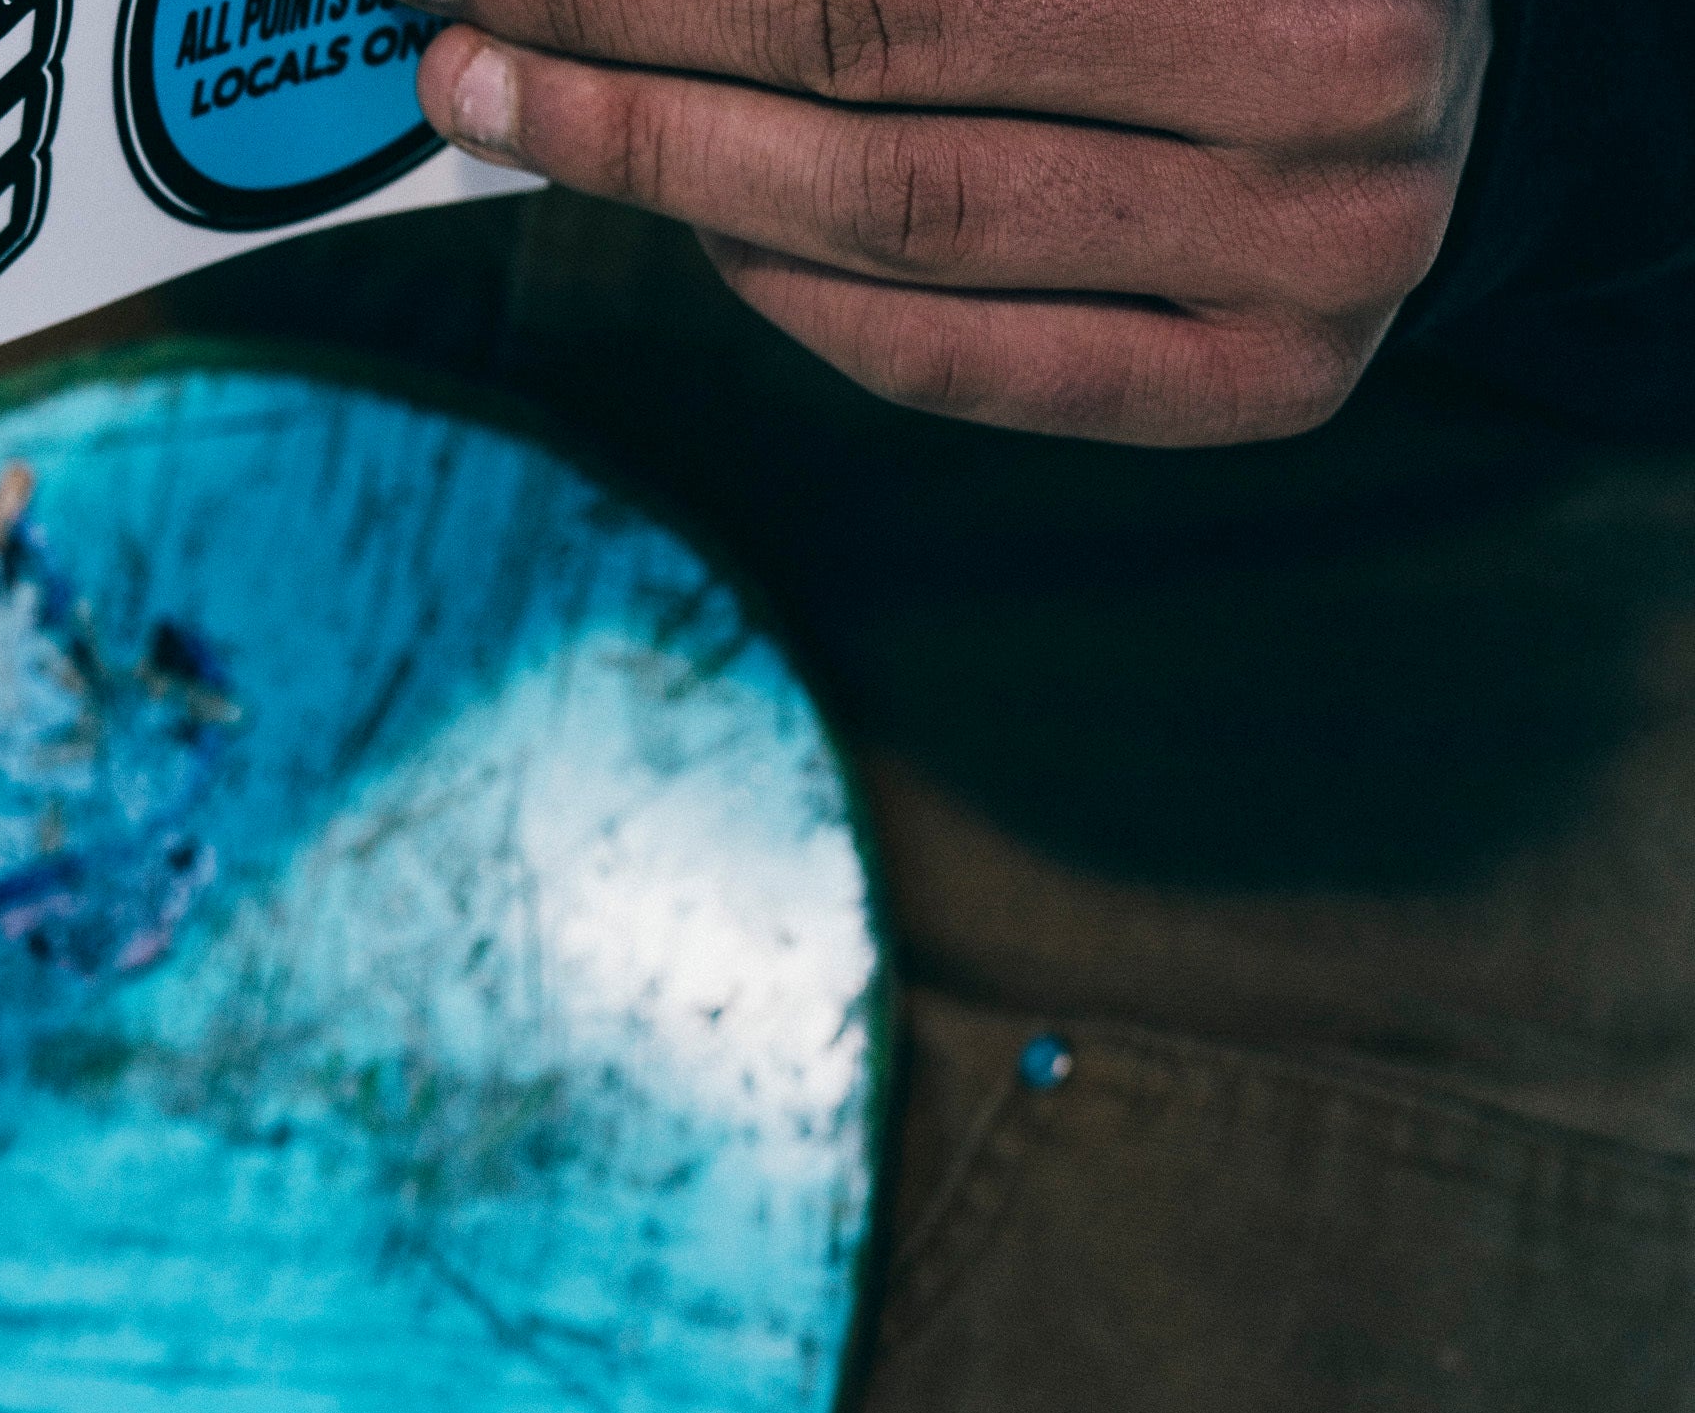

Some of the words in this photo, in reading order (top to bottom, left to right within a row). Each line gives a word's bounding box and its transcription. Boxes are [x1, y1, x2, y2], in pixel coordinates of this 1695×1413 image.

[175, 0, 232, 69] ALL
[191, 34, 352, 119] LOCALS
[362, 15, 448, 67] ON
